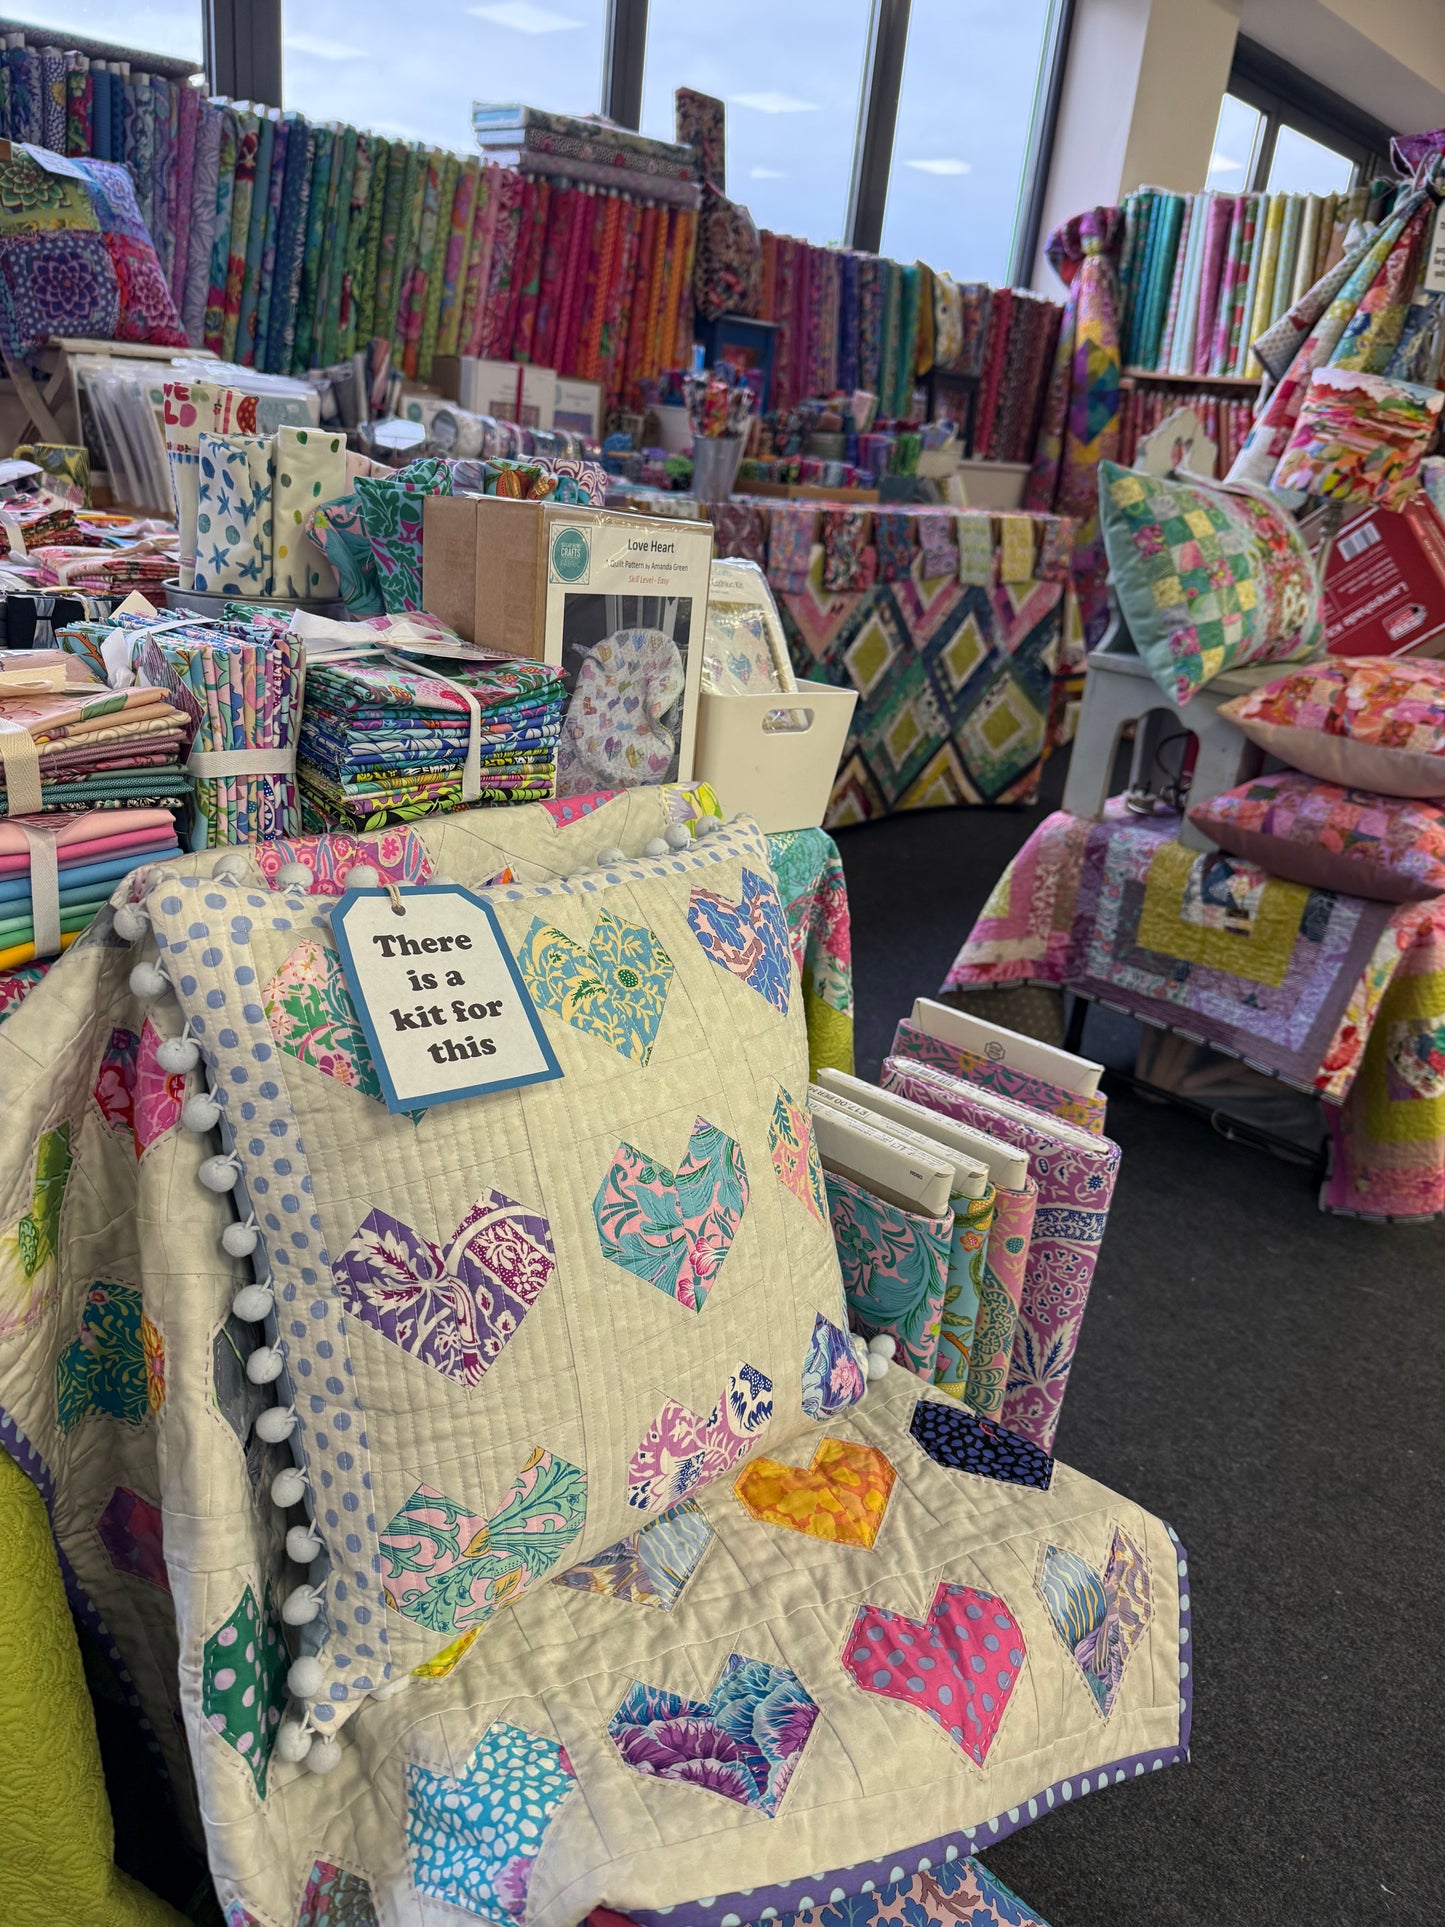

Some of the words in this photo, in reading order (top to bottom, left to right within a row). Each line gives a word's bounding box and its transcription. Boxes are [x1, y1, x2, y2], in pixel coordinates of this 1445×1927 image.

[561, 547, 581, 558] CRAFTS
[628, 539, 648, 551] Love
[651, 541, 674, 553] Heart
[611, 560, 624, 568] Quilt
[625, 561, 645, 569] Pattern
[651, 563, 672, 571] Amanda
[640, 576, 654, 584] Level
[658, 577, 670, 585] Easy
[1342, 581, 1409, 626] Lampshade
[373, 933, 472, 957] There
[406, 969, 438, 991] is
[445, 970, 465, 987] a
[390, 1005, 447, 1031] kit
[450, 1000, 503, 1022] for
[427, 1036, 497, 1064] this
[817, 1091, 835, 1101] PER
[834, 1099, 868, 1116] £17.00
